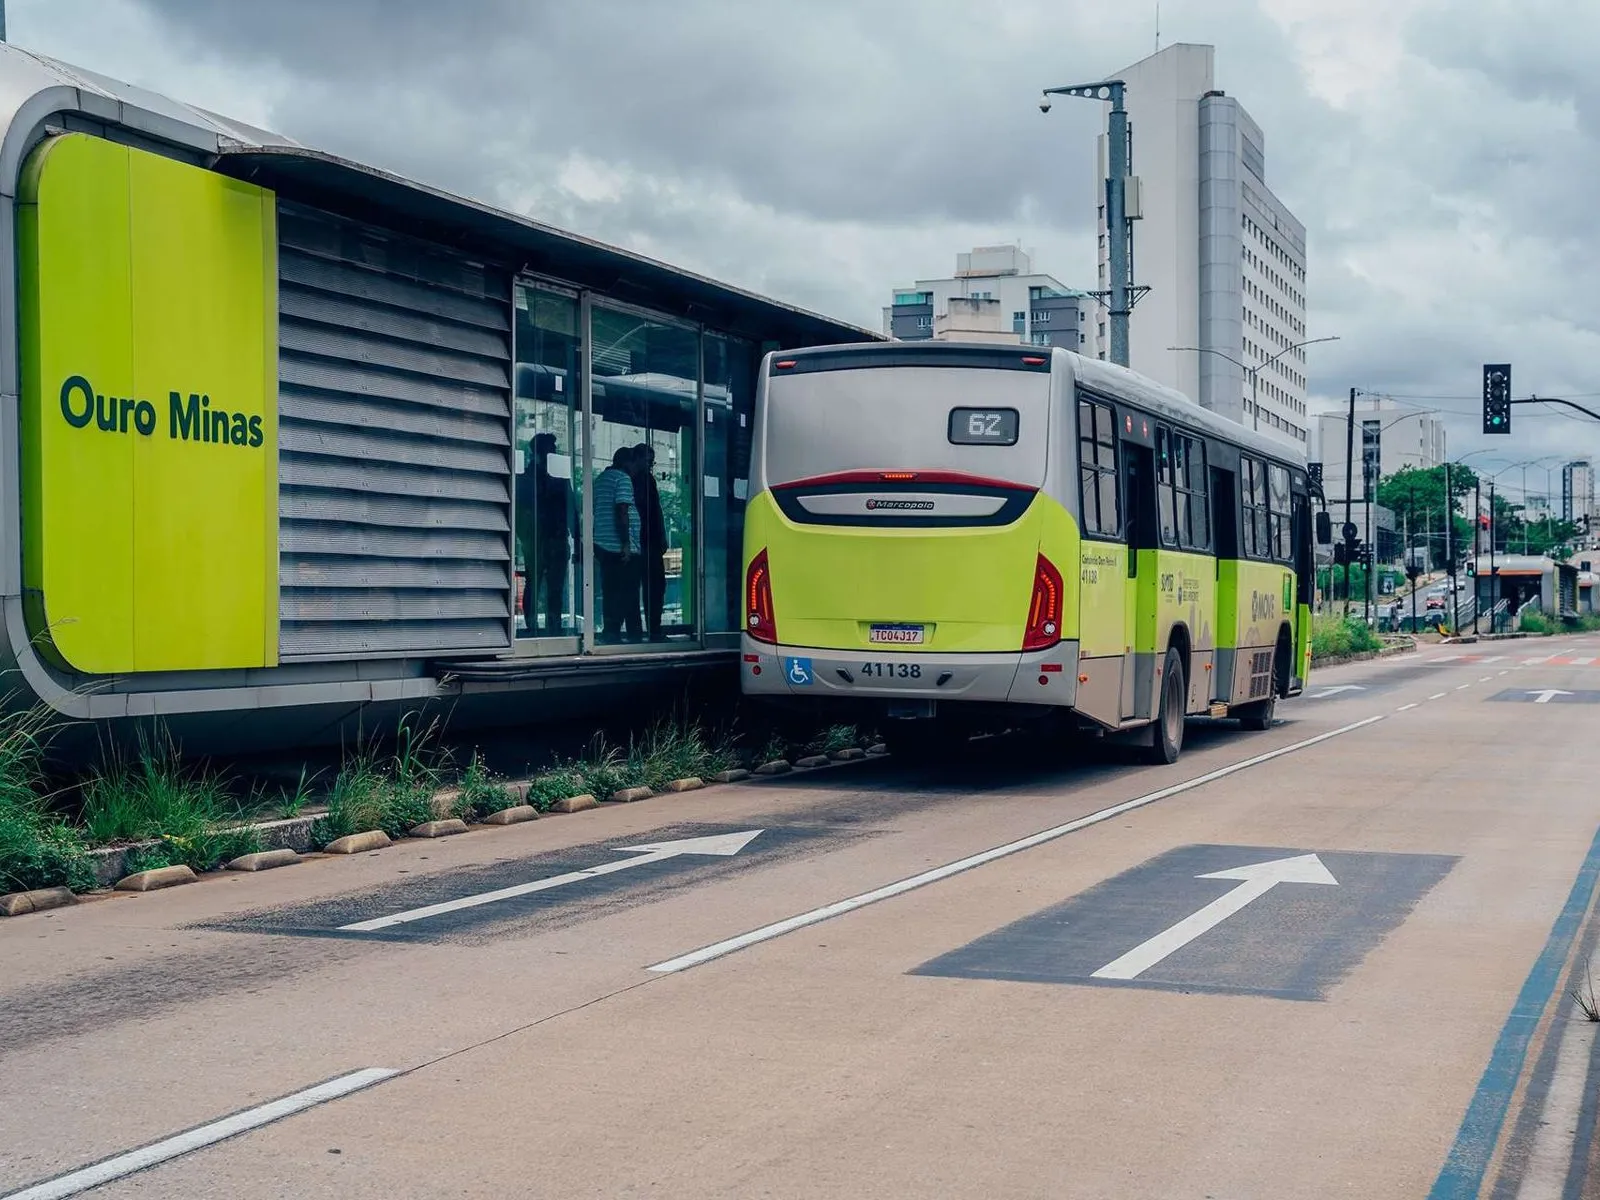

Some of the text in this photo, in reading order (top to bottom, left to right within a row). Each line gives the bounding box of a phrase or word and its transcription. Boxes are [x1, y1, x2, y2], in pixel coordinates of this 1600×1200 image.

[60, 375, 264, 448] Ouro Minas
[968, 413, 1002, 436] 62
[876, 501, 934, 509] Marcopolo
[1082, 569, 1098, 584] 41138
[861, 662, 921, 678] 41138
